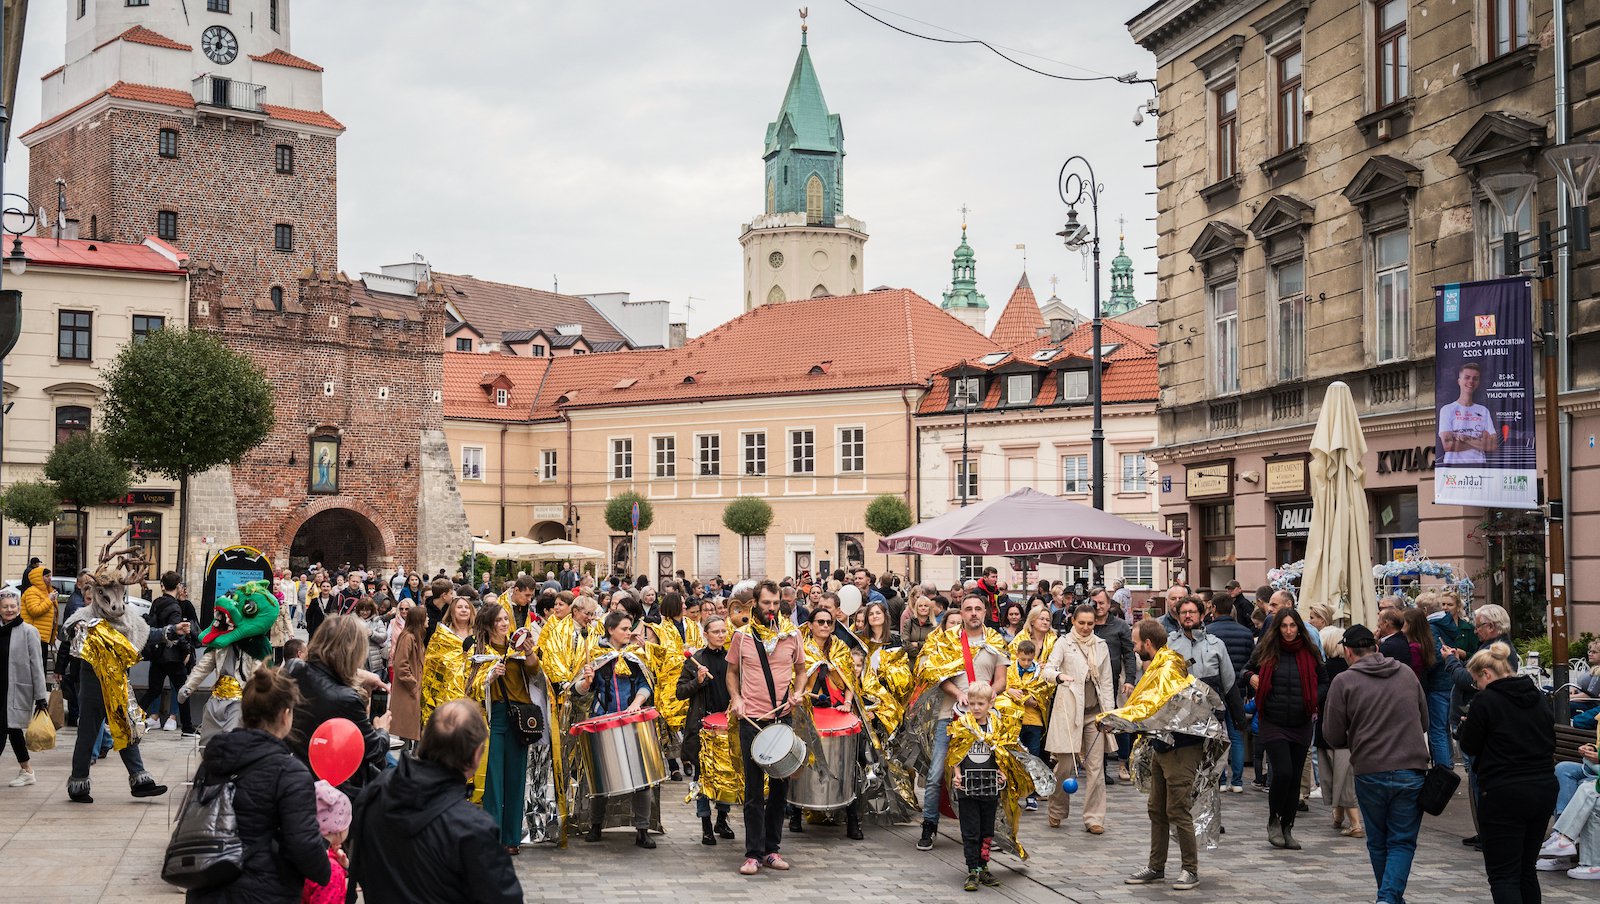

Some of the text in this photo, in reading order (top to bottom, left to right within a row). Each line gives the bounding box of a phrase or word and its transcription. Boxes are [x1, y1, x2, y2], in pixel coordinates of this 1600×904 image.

[1269, 462, 1303, 473] APARTAMENTY
[143, 493, 166, 503] Vegas
[1281, 508, 1313, 530] RALL
[1004, 537, 1131, 553] LODZIARNIA CARMELITO
